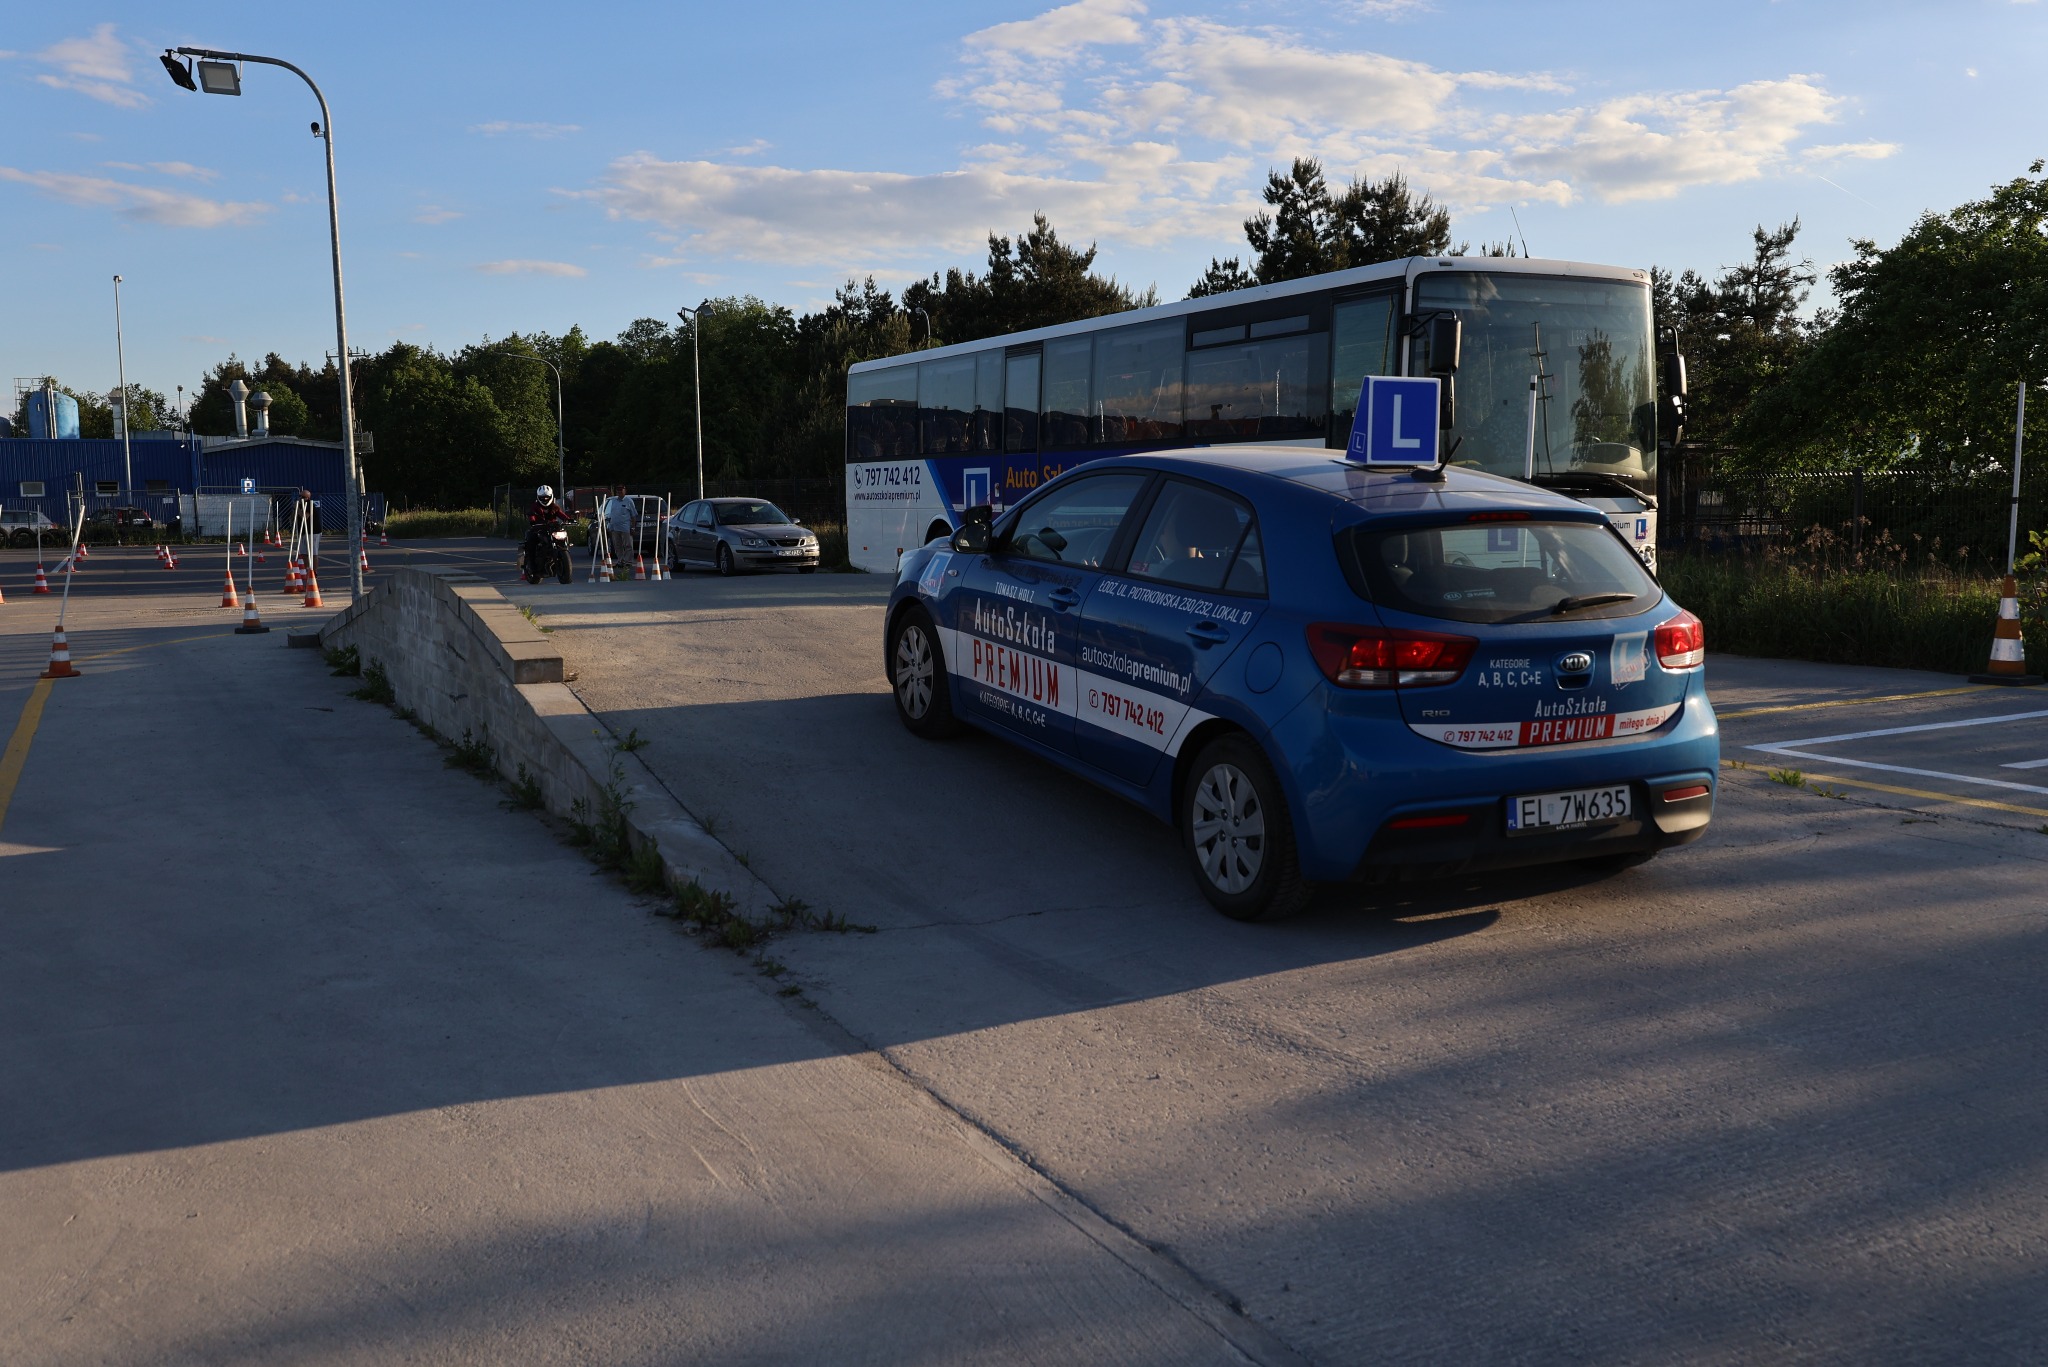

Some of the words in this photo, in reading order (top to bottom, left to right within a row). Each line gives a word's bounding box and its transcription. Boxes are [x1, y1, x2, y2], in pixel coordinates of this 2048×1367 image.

[1392, 394, 1421, 449] L
[1356, 436, 1362, 449] L
[244, 480, 253, 492] P
[865, 468, 881, 486] 797
[883, 467, 900, 486] 742
[903, 466, 920, 485] 412
[1006, 466, 1038, 488] Auto
[854, 490, 921, 502] www.autoszkolapremium.pl
[995, 581, 1018, 599] TOMASZ
[1018, 588, 1035, 604] HOLZ
[1127, 586, 1180, 609] PIOTRKOWSKA
[1178, 596, 1213, 618] 230/232,
[1211, 604, 1241, 623] LOKAL
[1239, 610, 1252, 625] 10
[974, 597, 1055, 654] AutoSzkoła
[973, 639, 1059, 707] PREMIUM
[1082, 646, 1192, 696] autoszkolapremium.pl
[1489, 658, 1531, 669] KATEGORIE
[1478, 672, 1490, 688] A,
[1493, 672, 1504, 688] B,
[1507, 671, 1518, 688] C,
[1520, 671, 1542, 686] C+E
[1101, 691, 1121, 718] 797
[1123, 698, 1144, 727] 742
[1146, 708, 1164, 735] 412
[1422, 709, 1451, 718] RIO
[1534, 695, 1607, 718] AutoSzkoła
[1032, 710, 1046, 727] C+E
[1619, 717, 1644, 730] miłego
[1645, 715, 1660, 726] dnia
[1457, 731, 1476, 742] 797
[1478, 730, 1495, 742] 742
[1497, 729, 1513, 741] 412
[1529, 716, 1607, 744] PREMIUM
[1522, 799, 1550, 827] EL
[1560, 789, 1626, 823] 7W635
[1508, 819, 1517, 828] PL
